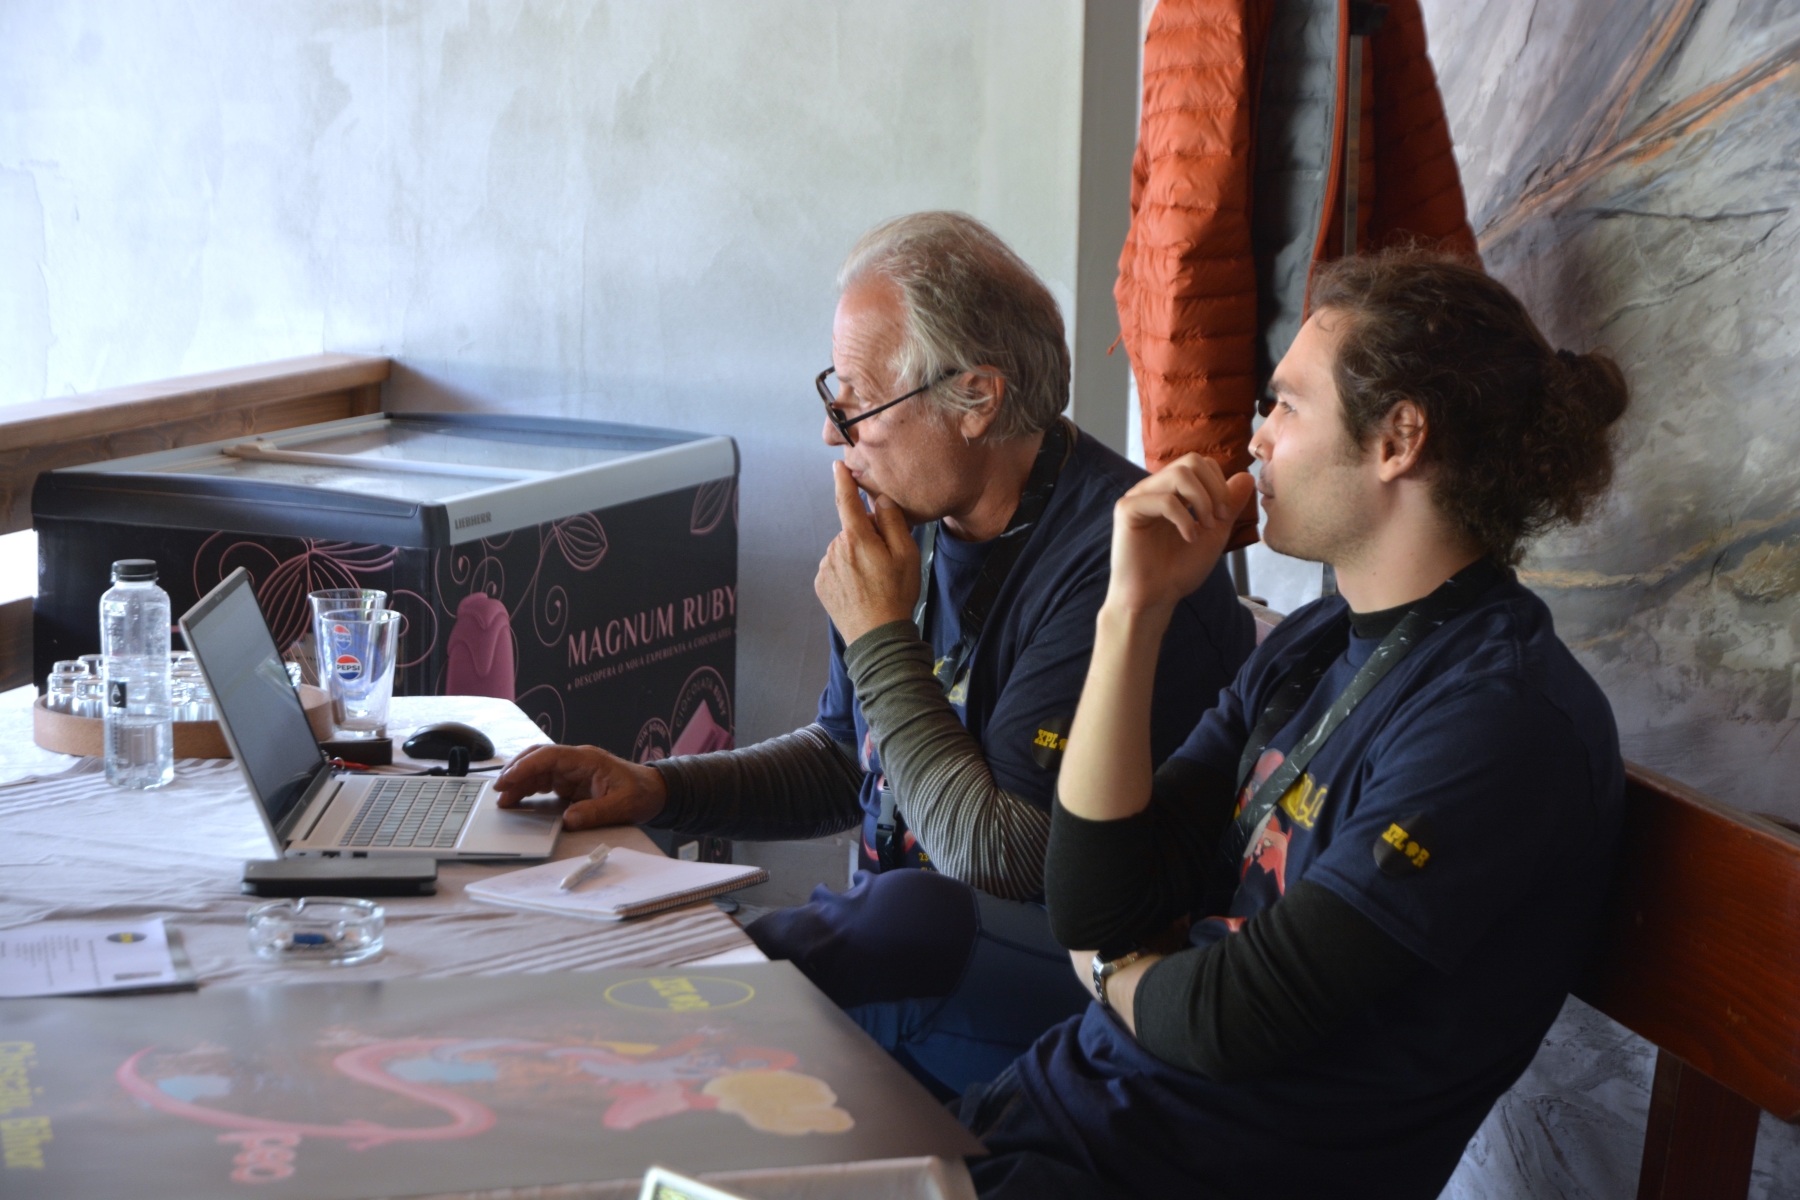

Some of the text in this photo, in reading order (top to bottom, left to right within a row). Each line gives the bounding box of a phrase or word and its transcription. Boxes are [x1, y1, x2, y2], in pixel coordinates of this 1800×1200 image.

[454, 511, 492, 530] LIEBHERR
[568, 584, 737, 668] MAGNUM RUBY
[336, 664, 360, 672] PEPSI
